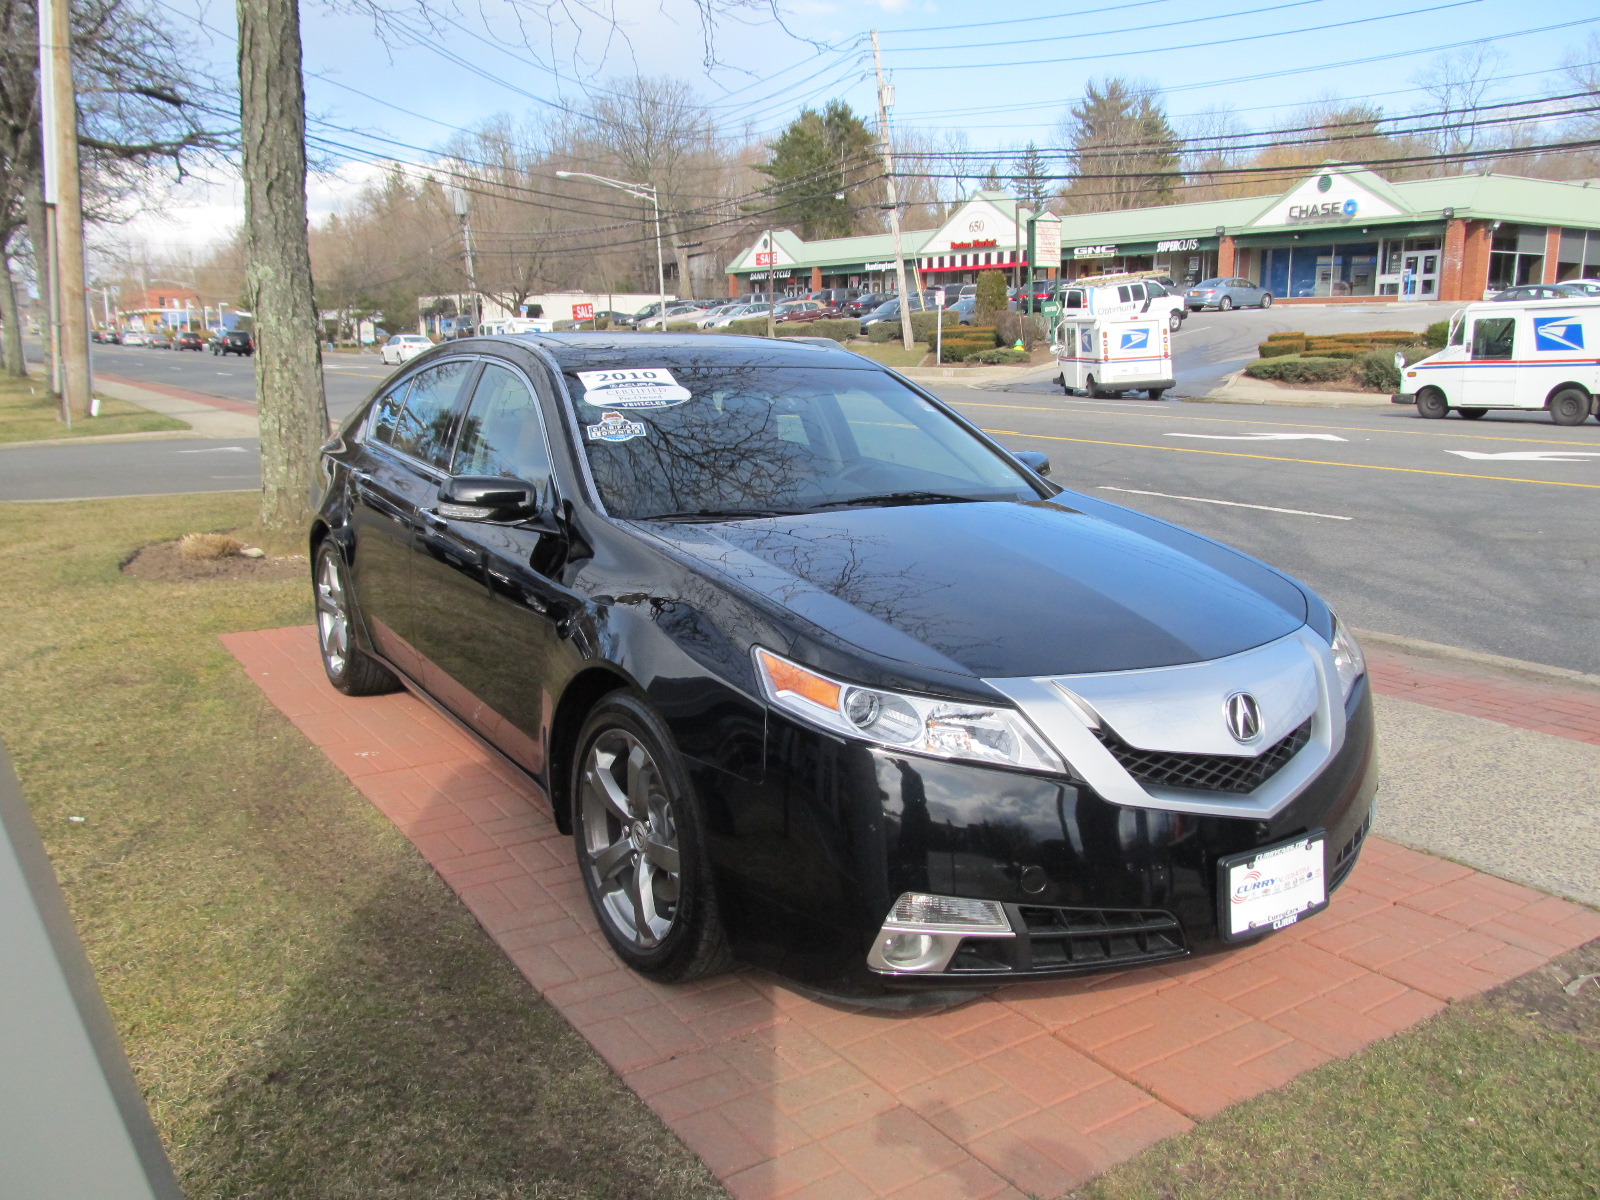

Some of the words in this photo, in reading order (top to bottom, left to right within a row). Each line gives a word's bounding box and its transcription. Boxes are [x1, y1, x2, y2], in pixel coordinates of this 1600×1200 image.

[1288, 202, 1342, 219] CHASE
[968, 220, 985, 233] 650
[973, 239, 997, 247] Market
[1156, 239, 1198, 252] SUPERCUTS
[1073, 244, 1116, 255] GNC
[576, 304, 593, 318] SALE
[1097, 304, 1135, 316] Optimum
[596, 371, 657, 382] 2010
[606, 387, 667, 396] CERTIFIED
[621, 400, 667, 408] VEHICLES
[592, 424, 641, 433] CARFAX
[1236, 878, 1277, 894] CURRY
[1273, 914, 1298, 930] CURRY
